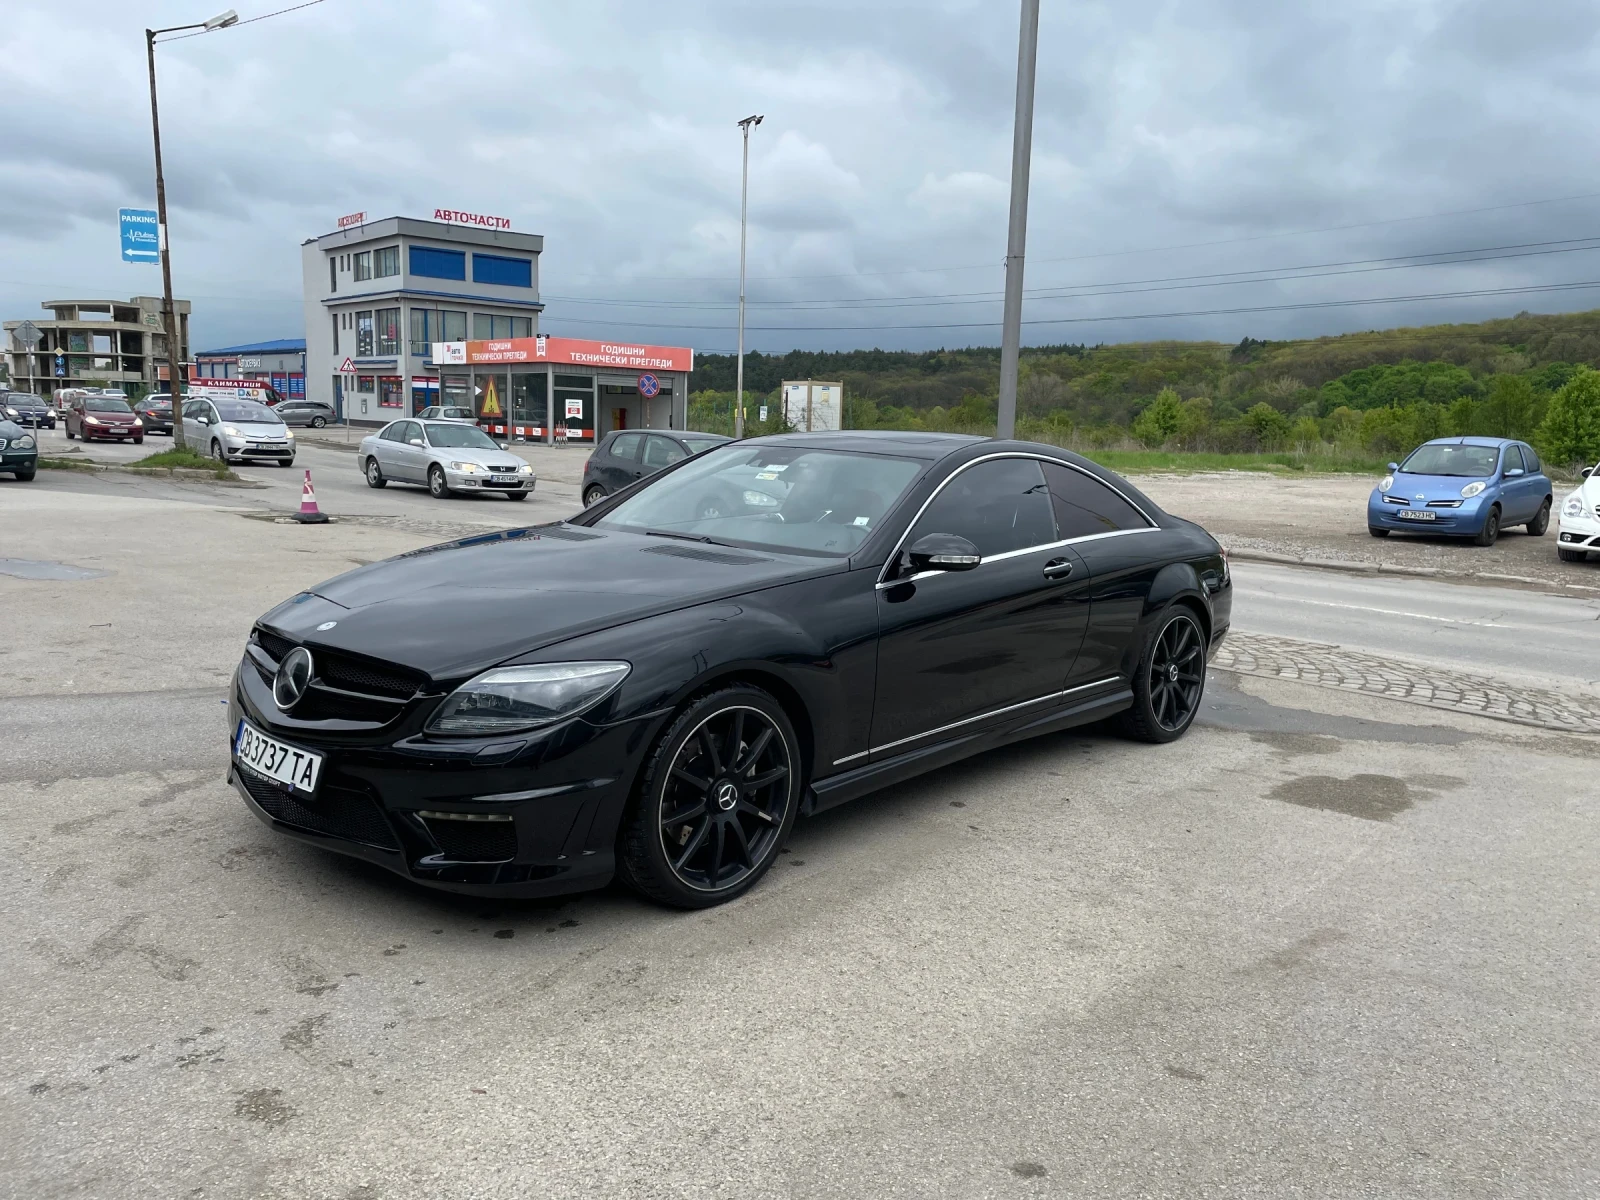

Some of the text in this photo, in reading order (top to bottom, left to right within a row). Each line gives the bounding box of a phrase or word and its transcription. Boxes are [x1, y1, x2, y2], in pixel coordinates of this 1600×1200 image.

[121, 215, 156, 223] PARKING
[434, 209, 510, 229] АВТОЧАСТИ
[488, 342, 511, 352] ГОДИШНИ
[601, 345, 645, 356] ГОДИШНИ
[472, 351, 527, 361] ТЕХНИЧЕСКИ ПРЕГЛЕДИ
[570, 352, 673, 369] ТЕХНИЧЕСКИ ПРЕГЛЕДИ
[208, 380, 261, 388] КЛИМАТИЦИ
[291, 751, 314, 787] TA
